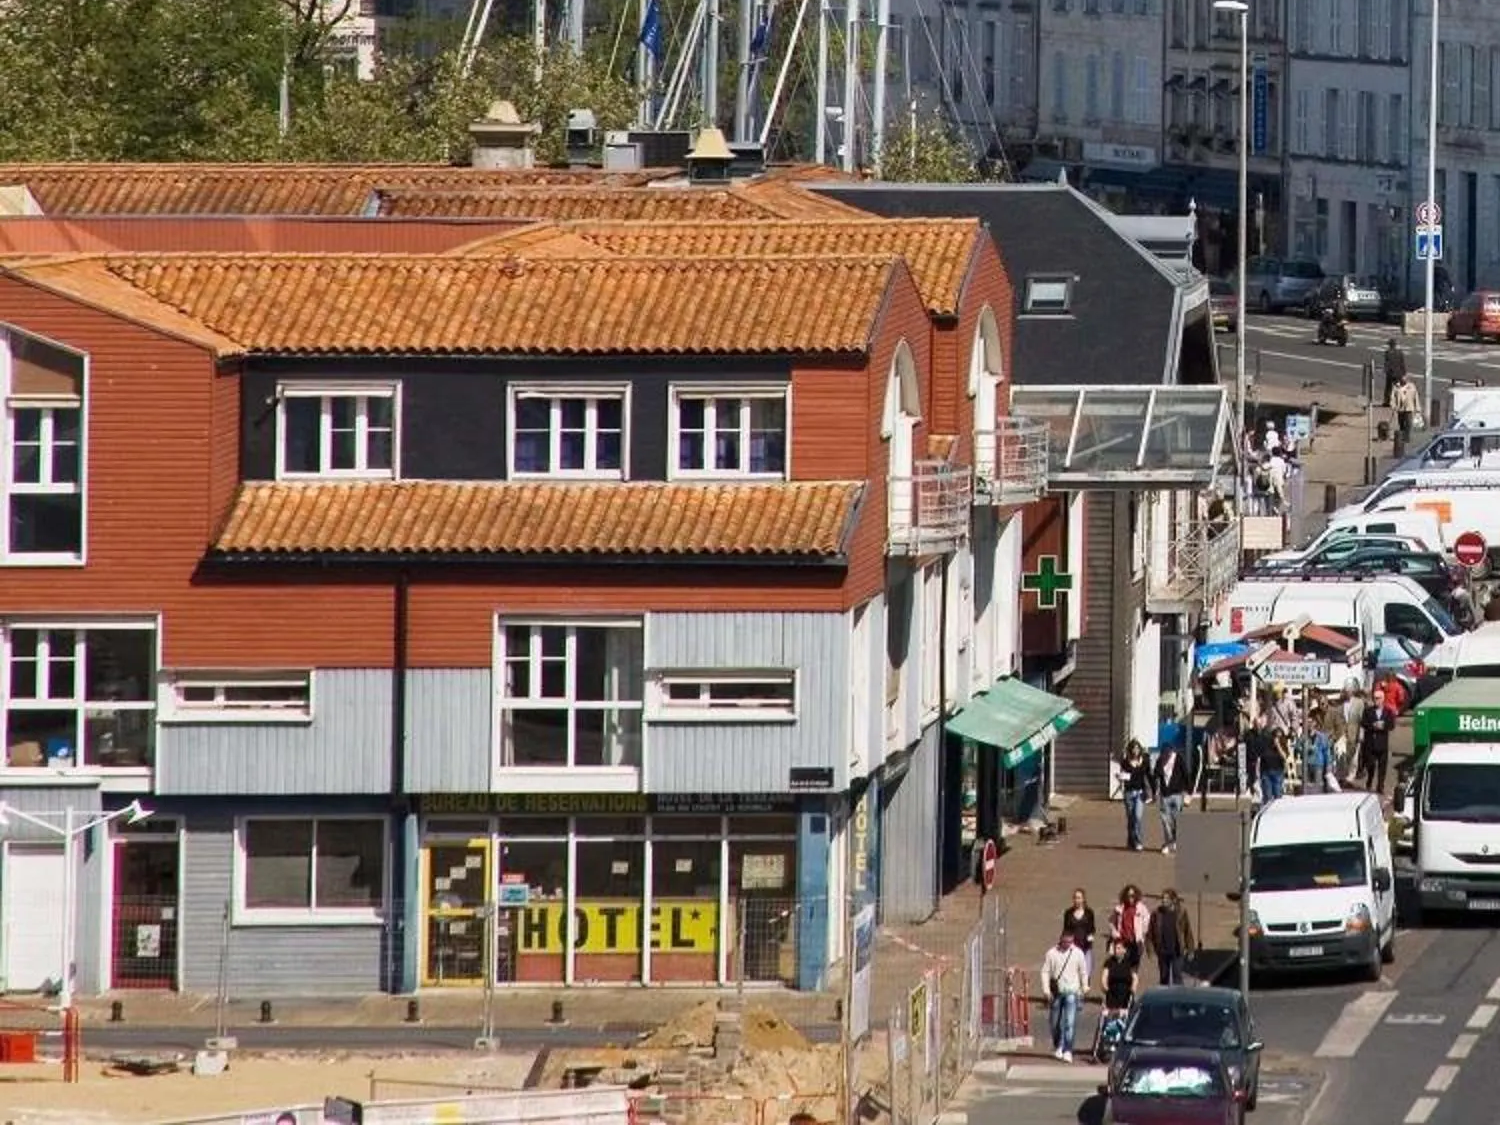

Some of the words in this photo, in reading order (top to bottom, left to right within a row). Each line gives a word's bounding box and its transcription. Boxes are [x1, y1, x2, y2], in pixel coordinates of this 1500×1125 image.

[422, 793, 488, 812] BUREAU
[495, 793, 518, 812] DE
[855, 793, 867, 890] HOTEL
[523, 907, 696, 948] HOTEL
